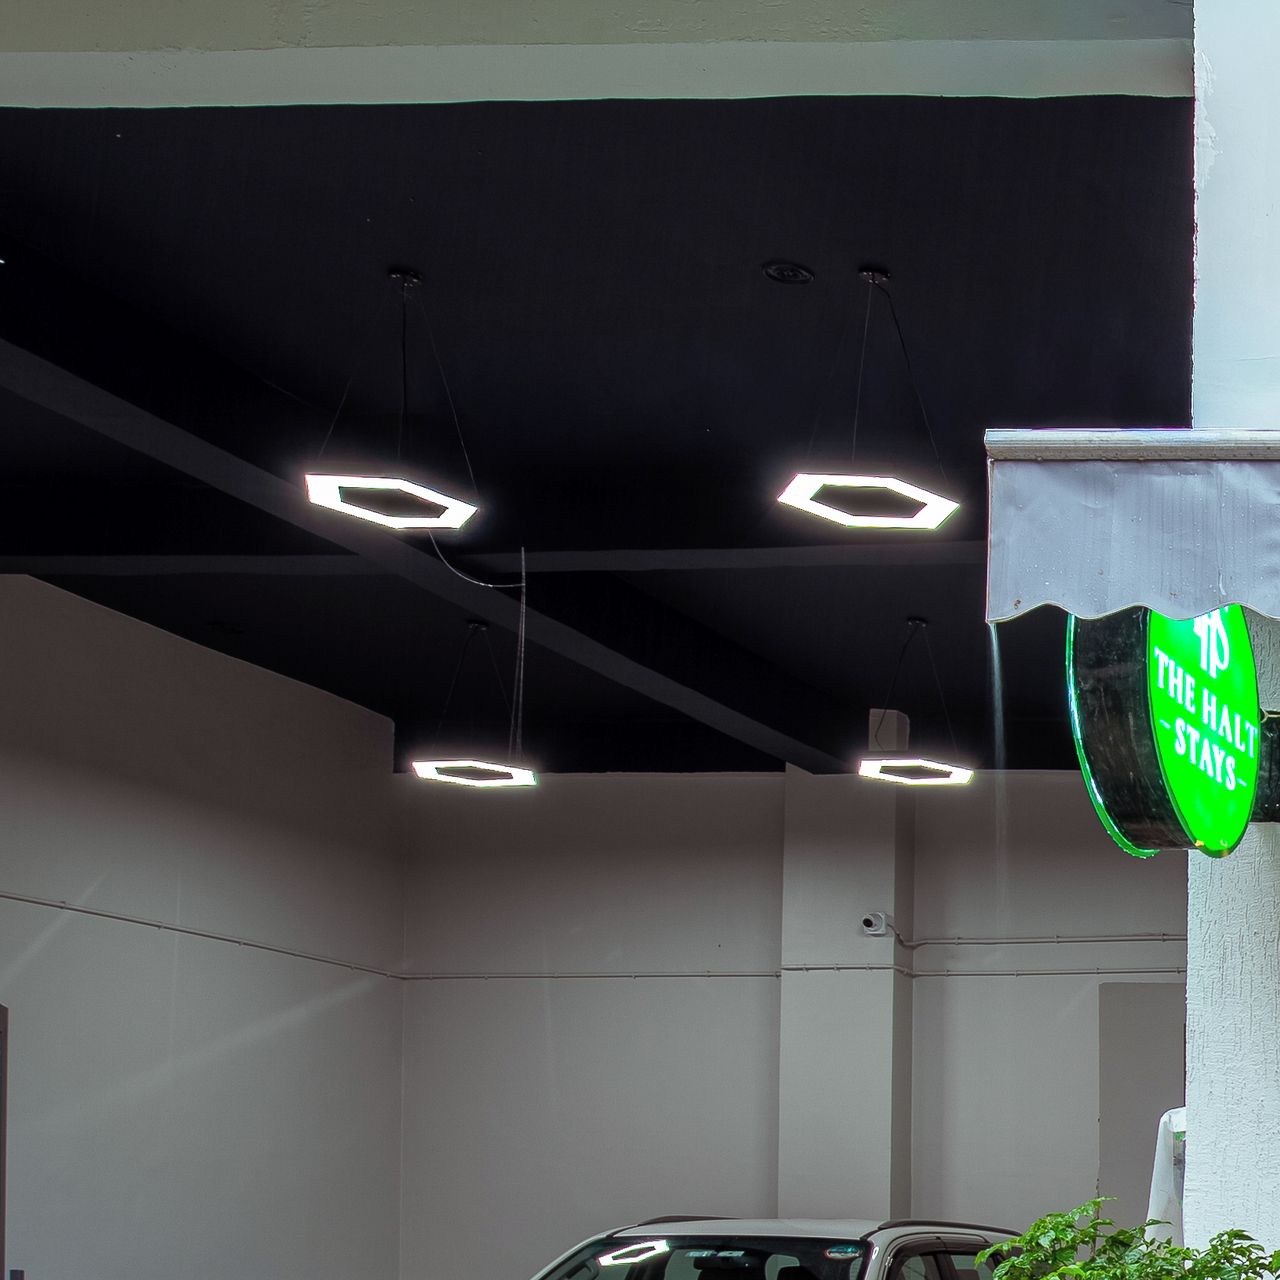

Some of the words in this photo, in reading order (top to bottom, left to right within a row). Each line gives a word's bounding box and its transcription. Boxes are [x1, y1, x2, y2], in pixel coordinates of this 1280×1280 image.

[1153, 646, 1197, 715] THE
[1202, 687, 1259, 759] HALT
[1174, 717, 1237, 791] STAYS
